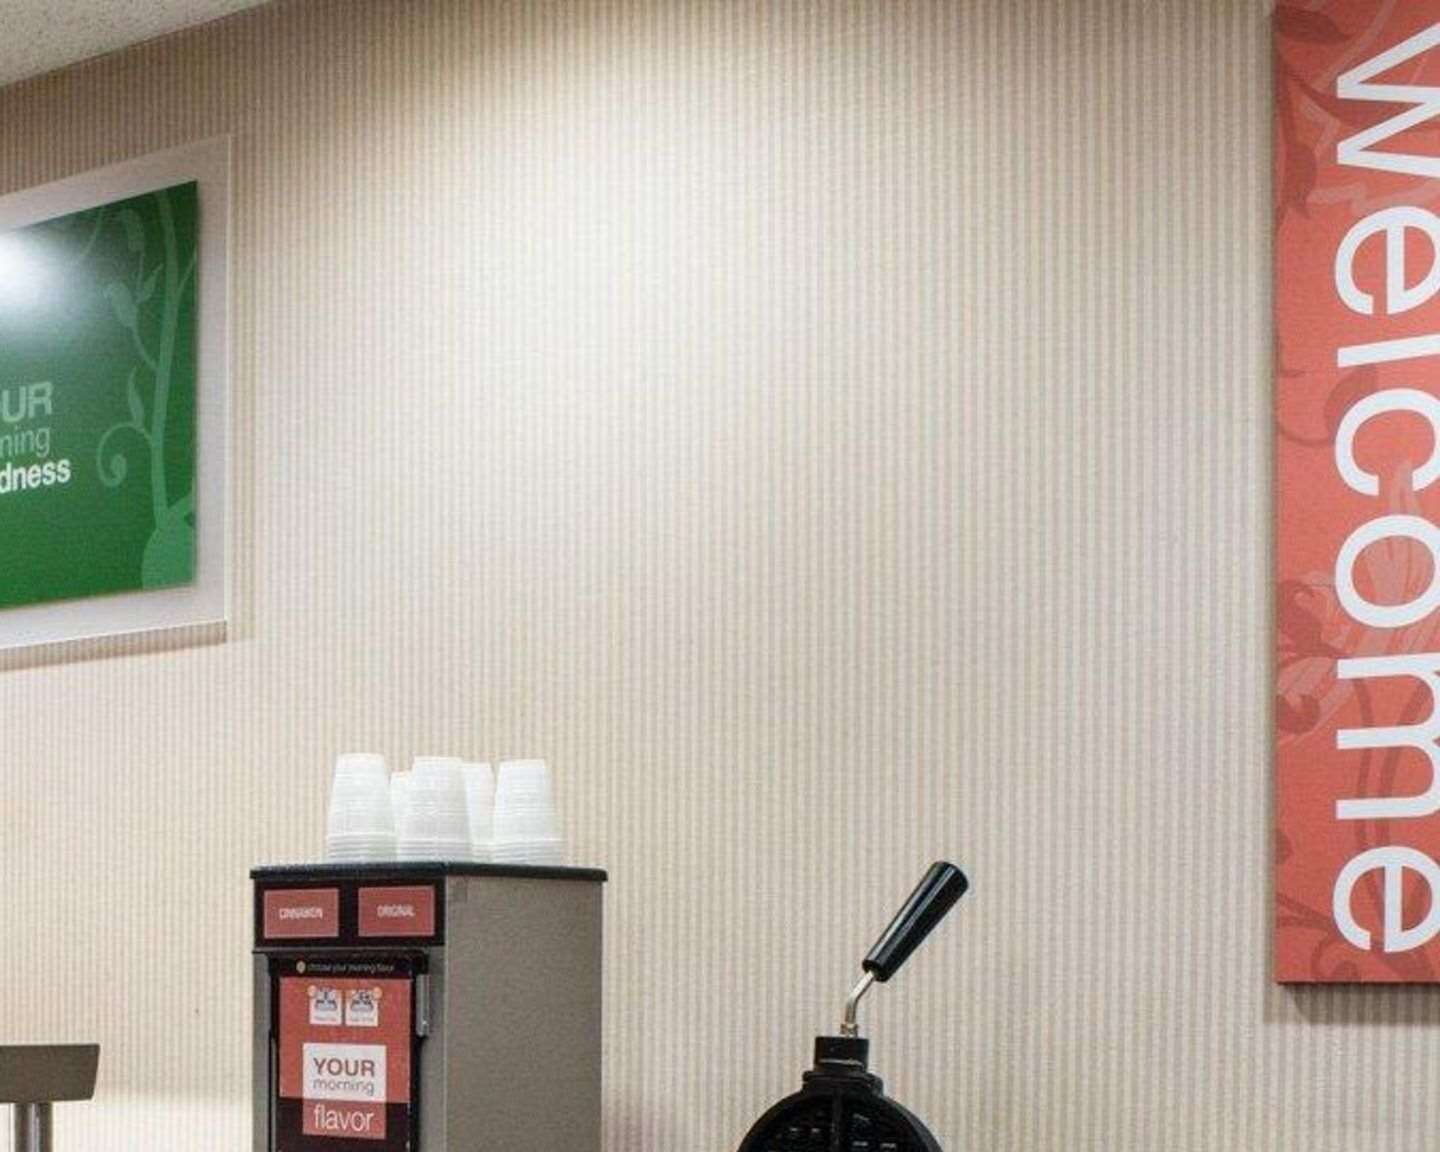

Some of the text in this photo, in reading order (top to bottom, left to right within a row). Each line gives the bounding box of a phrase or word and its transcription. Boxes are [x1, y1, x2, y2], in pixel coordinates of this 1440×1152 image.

[313, 1057, 375, 1078] YOUR
[313, 1077, 375, 1097] morning
[313, 1103, 374, 1132] flavor
